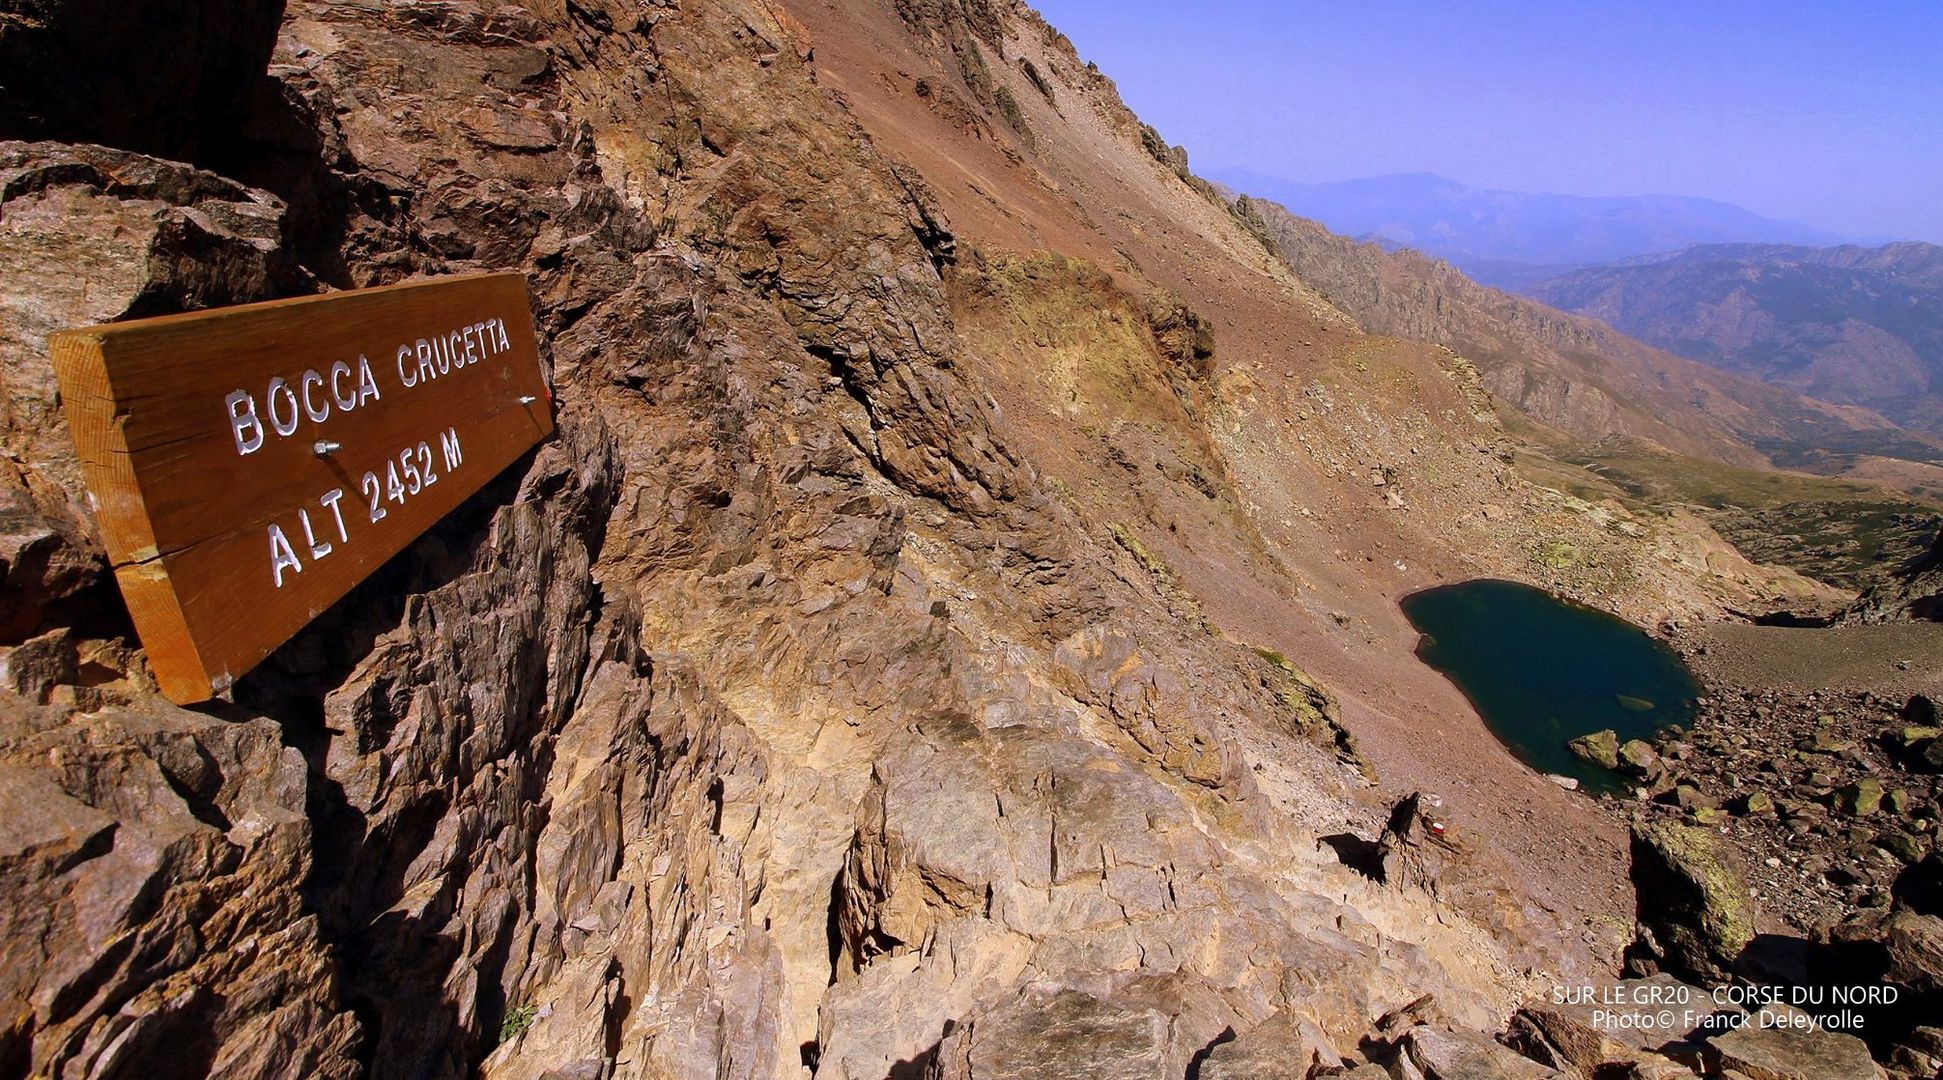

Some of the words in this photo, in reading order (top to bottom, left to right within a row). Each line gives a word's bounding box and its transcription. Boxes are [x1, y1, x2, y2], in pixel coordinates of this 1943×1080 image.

[225, 353, 381, 456] BOCCA
[396, 318, 511, 388] CRUCETTA
[267, 488, 349, 588] ALT
[361, 440, 438, 524] 2452
[439, 426, 463, 473] M
